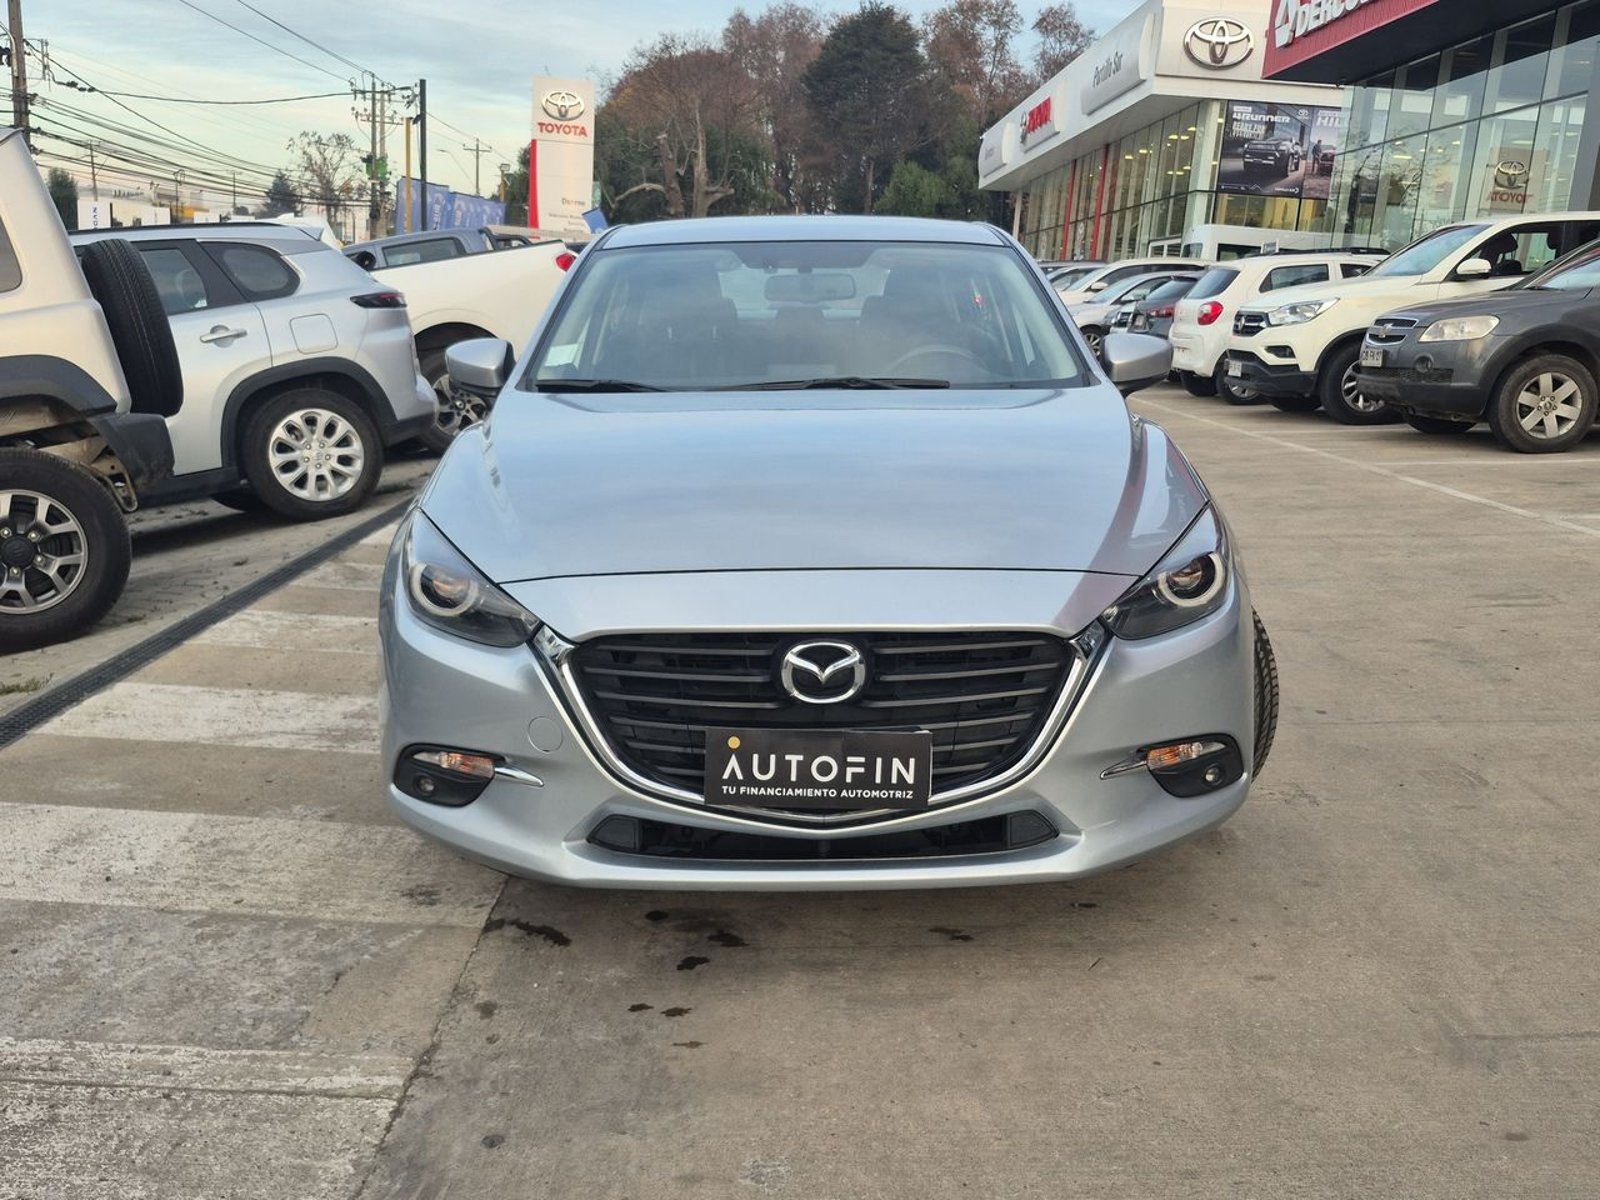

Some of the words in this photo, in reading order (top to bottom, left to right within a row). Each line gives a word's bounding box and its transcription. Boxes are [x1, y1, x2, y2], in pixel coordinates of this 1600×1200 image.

[538, 122, 588, 137] TOYOTA
[722, 752, 915, 784] AUTOFIN
[722, 786, 736, 795] TU
[740, 786, 837, 797] FINANCIAMIENTO
[840, 789, 914, 799] AUTOMOTRIZ
